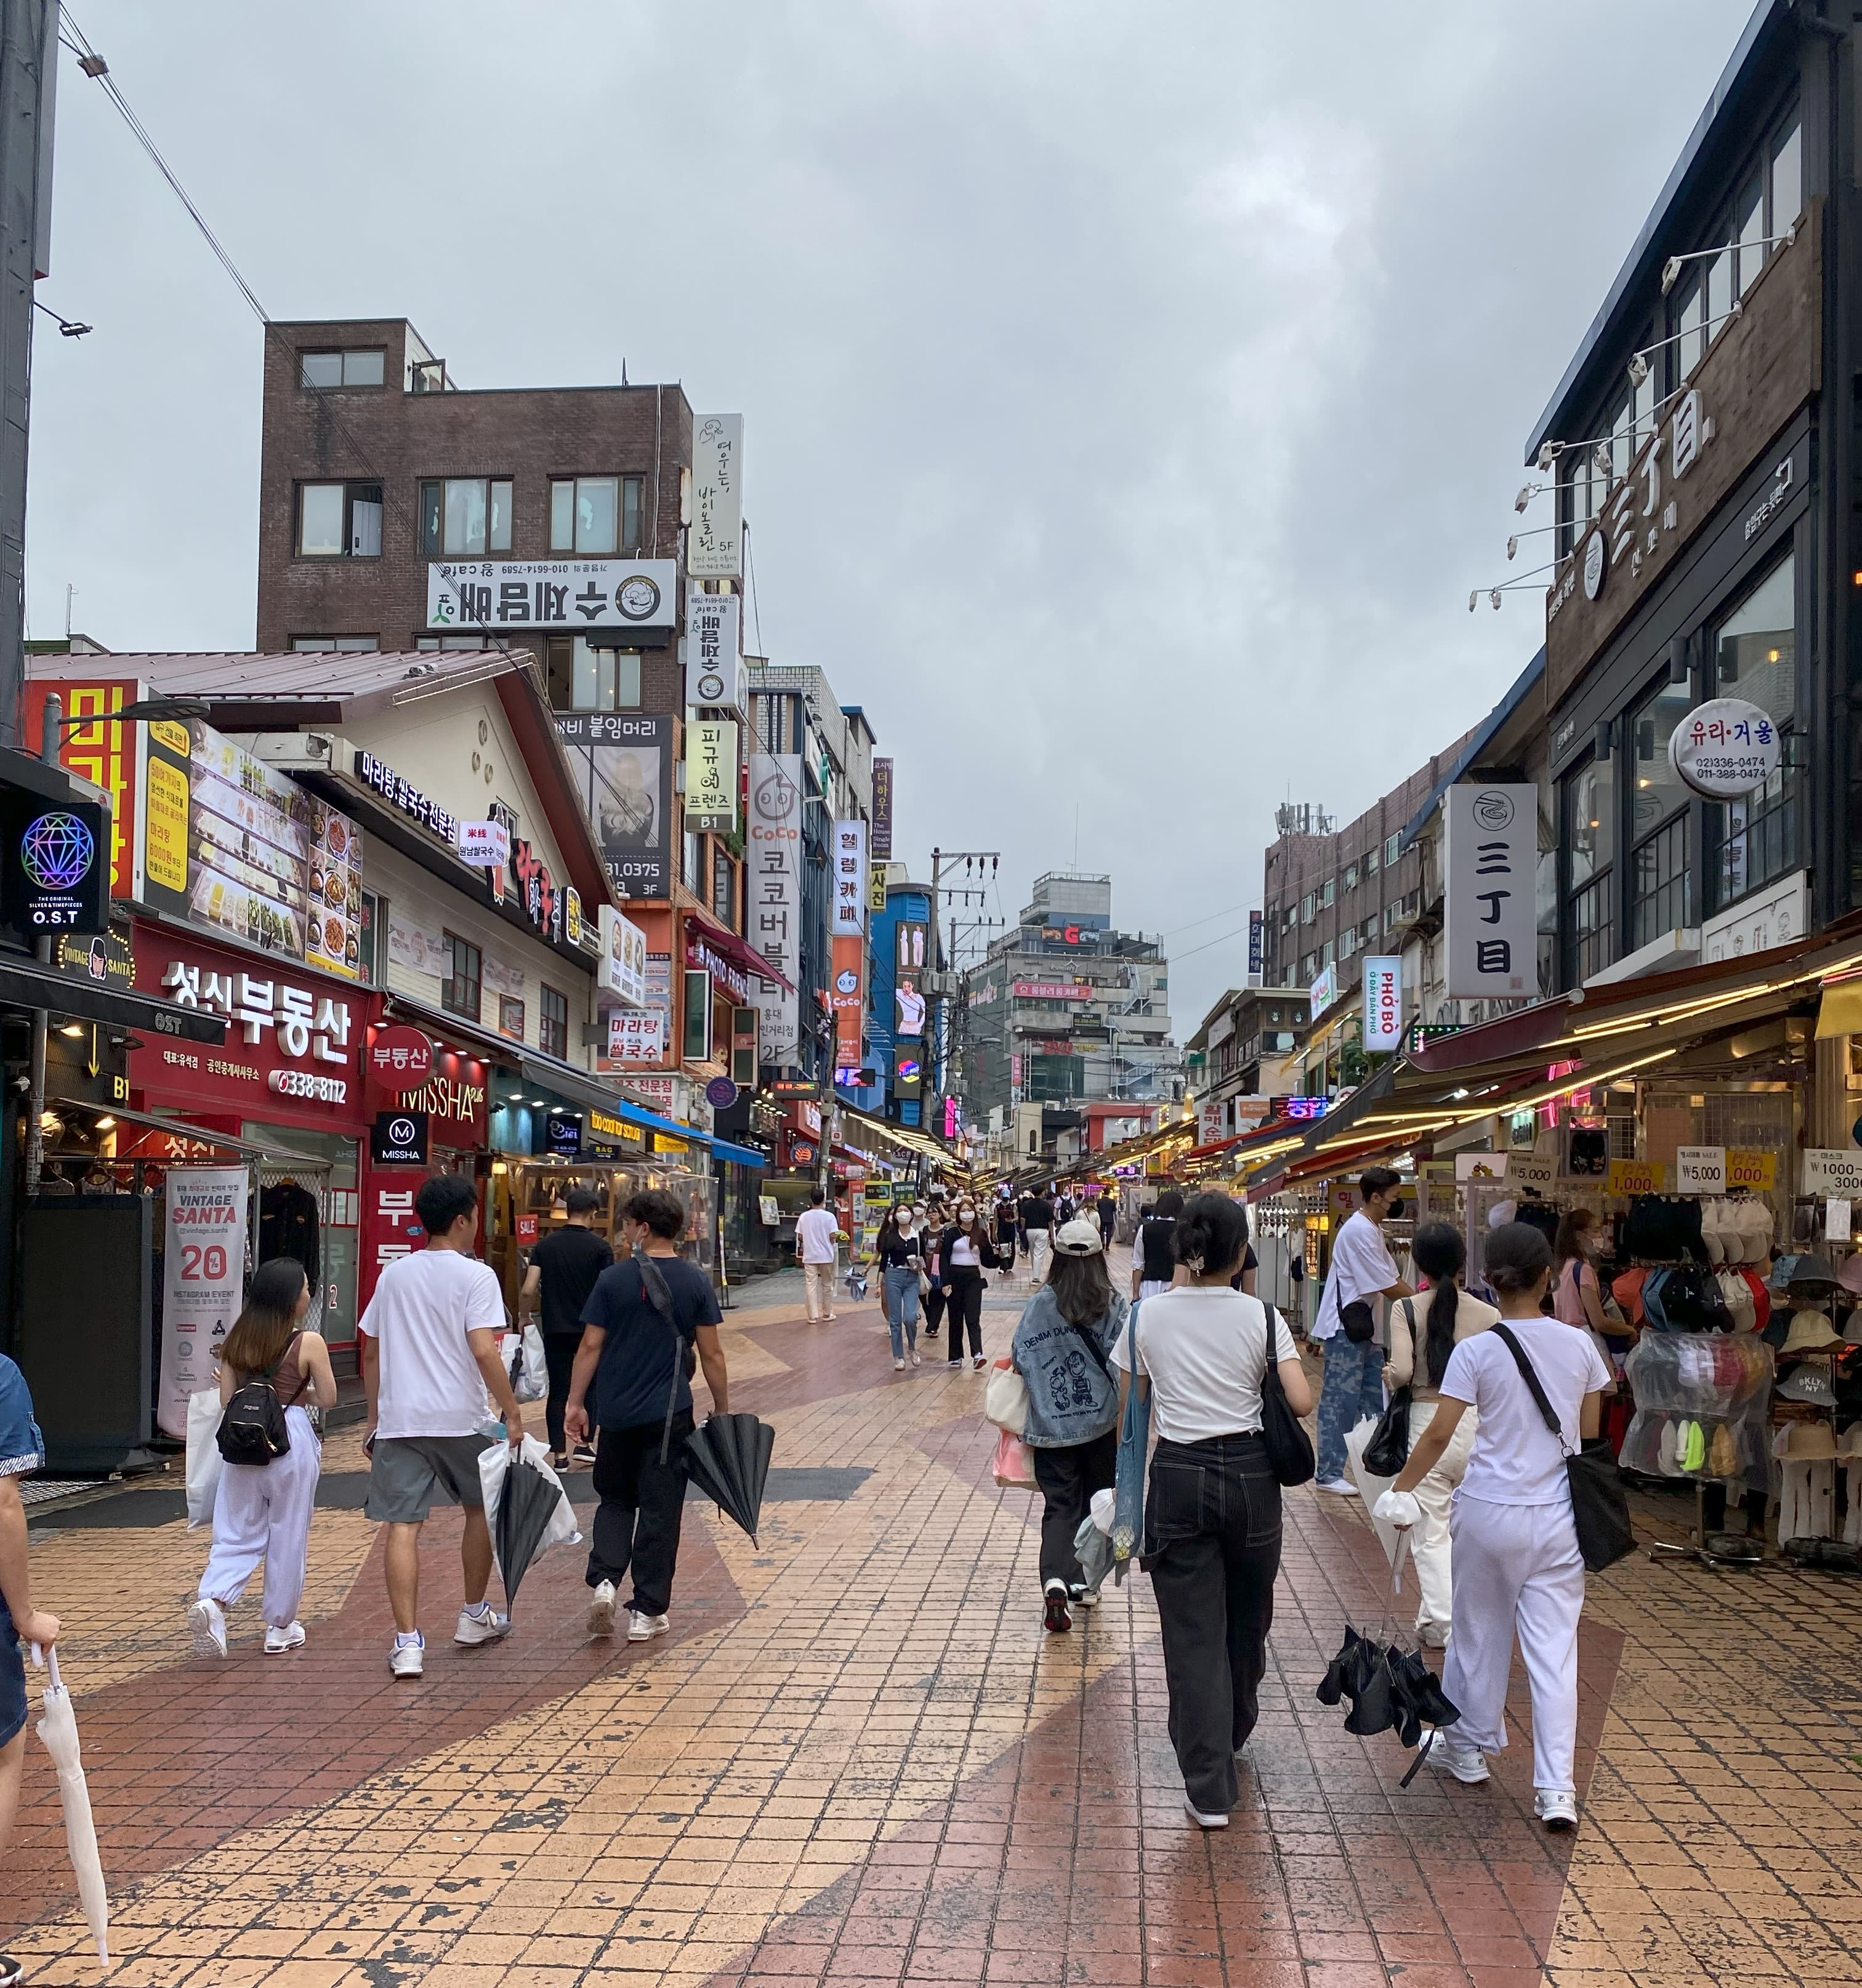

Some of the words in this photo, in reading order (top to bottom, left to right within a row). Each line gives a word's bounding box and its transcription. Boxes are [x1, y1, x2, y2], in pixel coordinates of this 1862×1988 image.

[719, 542, 735, 552] 5F
[481, 563, 494, 576] 왕
[502, 564, 568, 574] 010-6614-7589
[460, 581, 607, 621] 수제담배
[699, 616, 720, 672] 수제담배
[589, 715, 656, 739] 붙임머리
[1696, 757, 1765, 768] 02)336-0474
[688, 794, 730, 809] 프렌즈
[876, 772, 889, 821] 더하우스
[429, 800, 456, 844] 전문점
[700, 816, 718, 829] B1
[150, 821, 171, 843] 마라탕
[839, 833, 858, 922] 힐링카페
[643, 884, 658, 896] 3F
[33, 911, 78, 924] O.S.T
[1475, 842, 1512, 974] 三丁目
[64, 946, 89, 966] VINTAGE
[108, 959, 131, 977] SANTA
[706, 946, 727, 984] PHOTO
[1382, 972, 1400, 1007] PHỞ
[155, 1012, 182, 1034] OST
[764, 1008, 782, 1021] 홍대
[1382, 1011, 1400, 1034] BÒ
[611, 1019, 658, 1034] 마라탕
[373, 1048, 429, 1069] 부동산
[610, 1045, 658, 1059] 쌀국수
[763, 1045, 784, 1061] 2F
[206, 1058, 260, 1081] 공인중개사사무소
[114, 1076, 129, 1101] B1
[288, 1070, 347, 1104] 338-8112
[639, 1079, 672, 1093] 전문점
[382, 1150, 420, 1160] MISSHA
[180, 1194, 232, 1206] VINTAGE
[172, 1207, 236, 1225] SANTA
[1024, 1330, 1052, 1349] DENIM
[1805, 1384, 1818, 1393] NY
